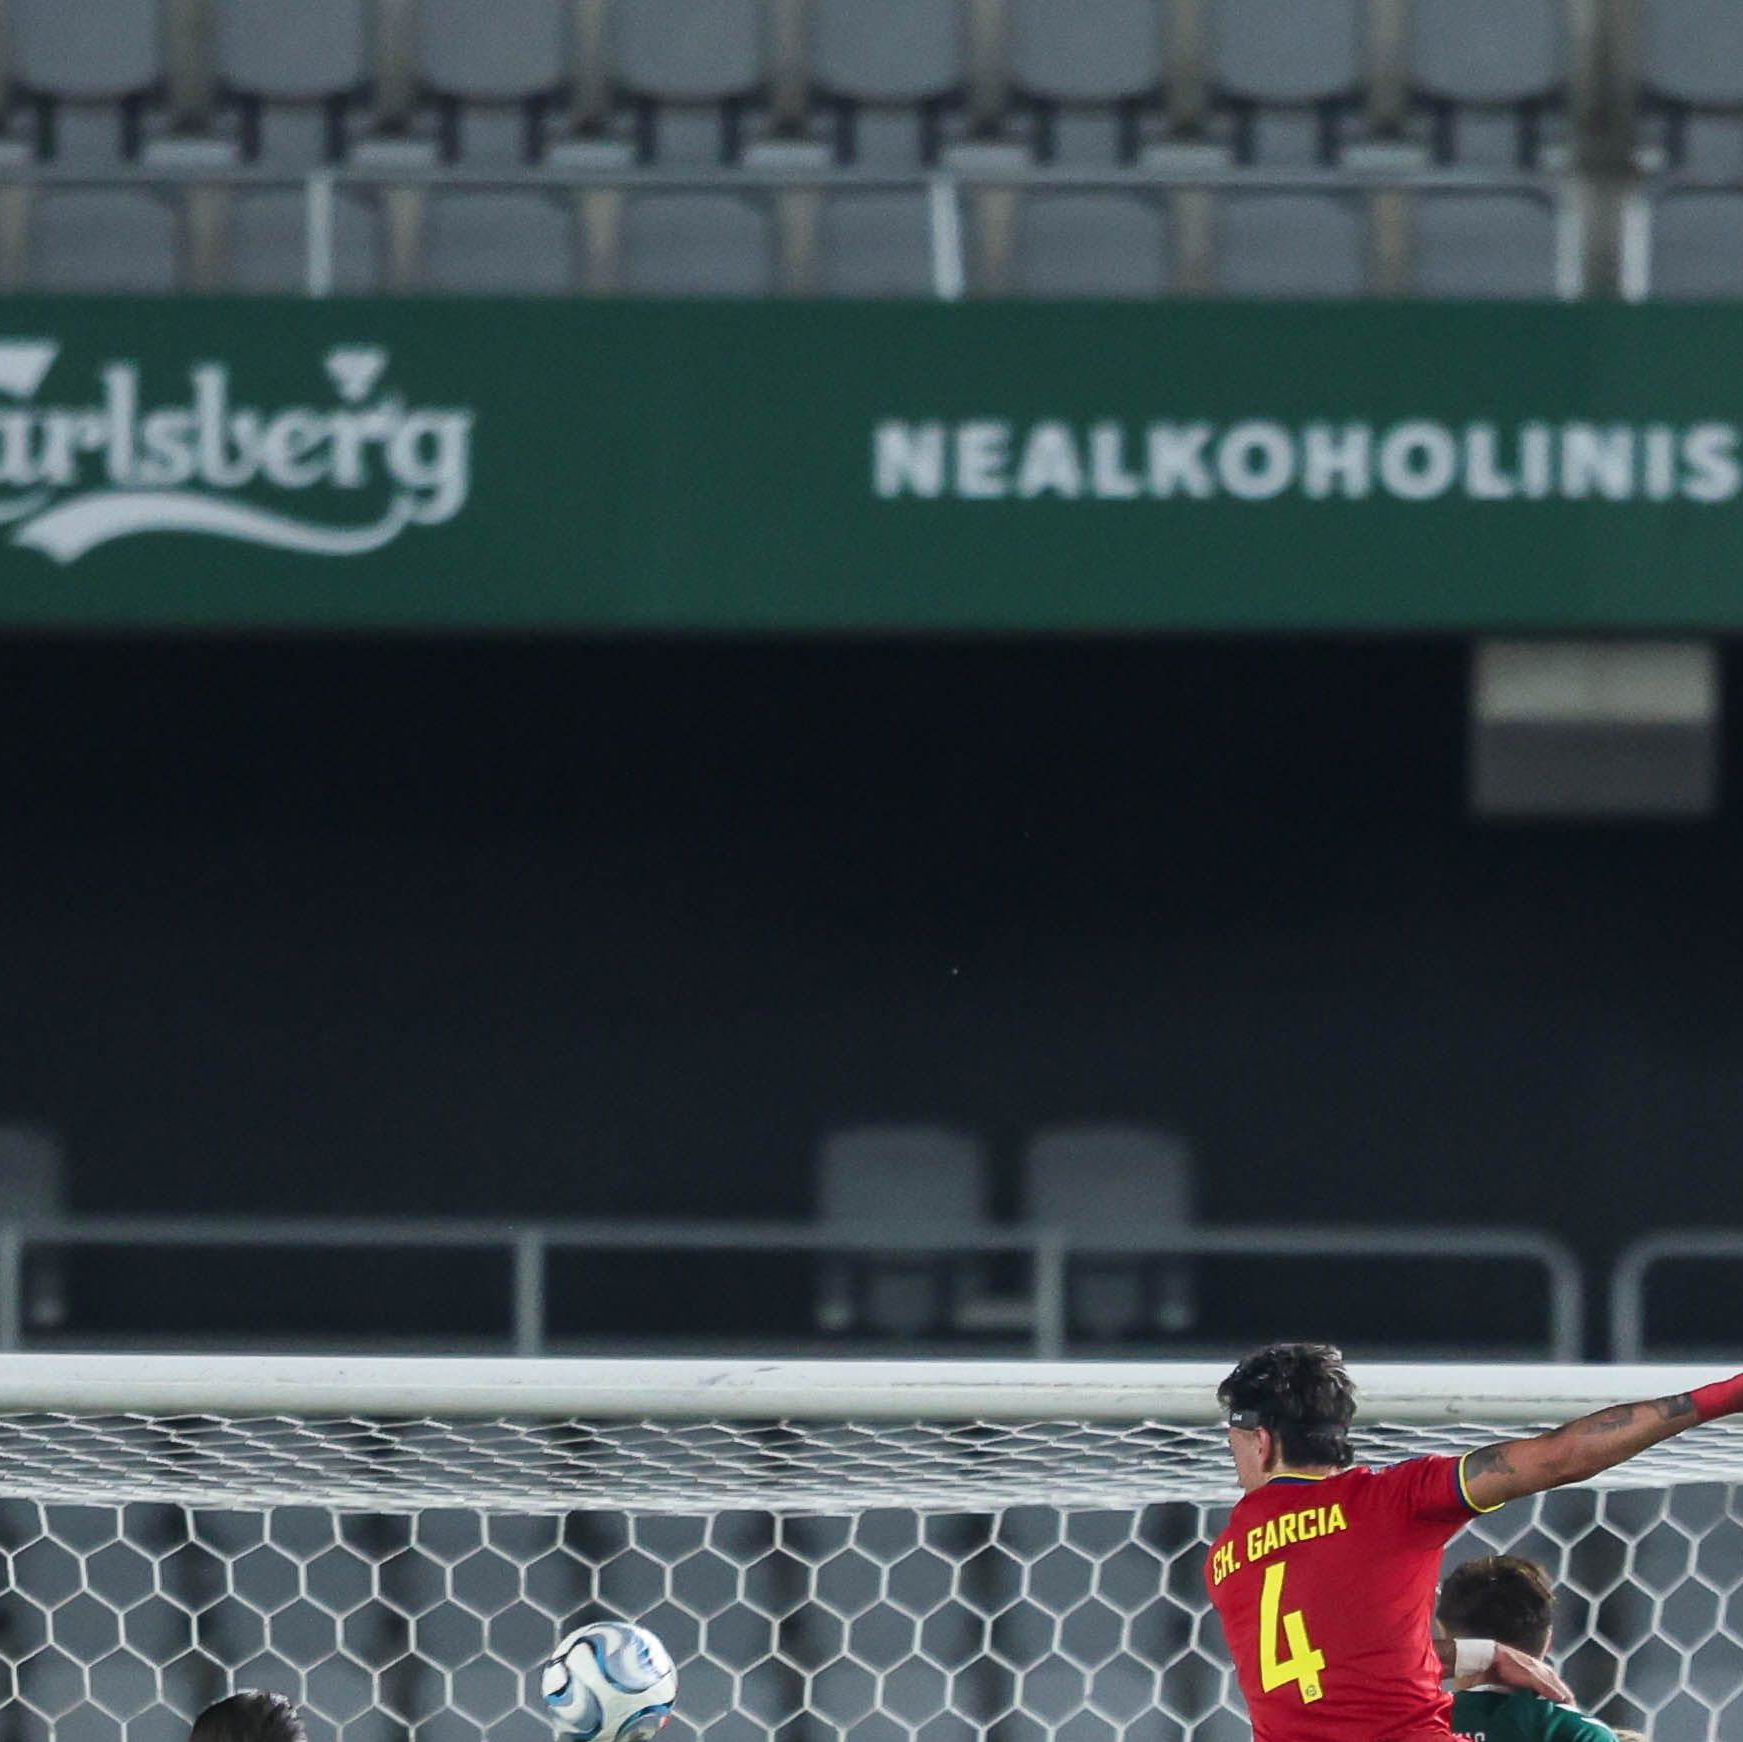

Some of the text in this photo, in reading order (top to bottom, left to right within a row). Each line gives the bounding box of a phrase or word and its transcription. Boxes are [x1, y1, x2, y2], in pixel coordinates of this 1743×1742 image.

[1212, 1503, 1348, 1586] CH. GARCIA
[1259, 1561, 1326, 1704] 4
